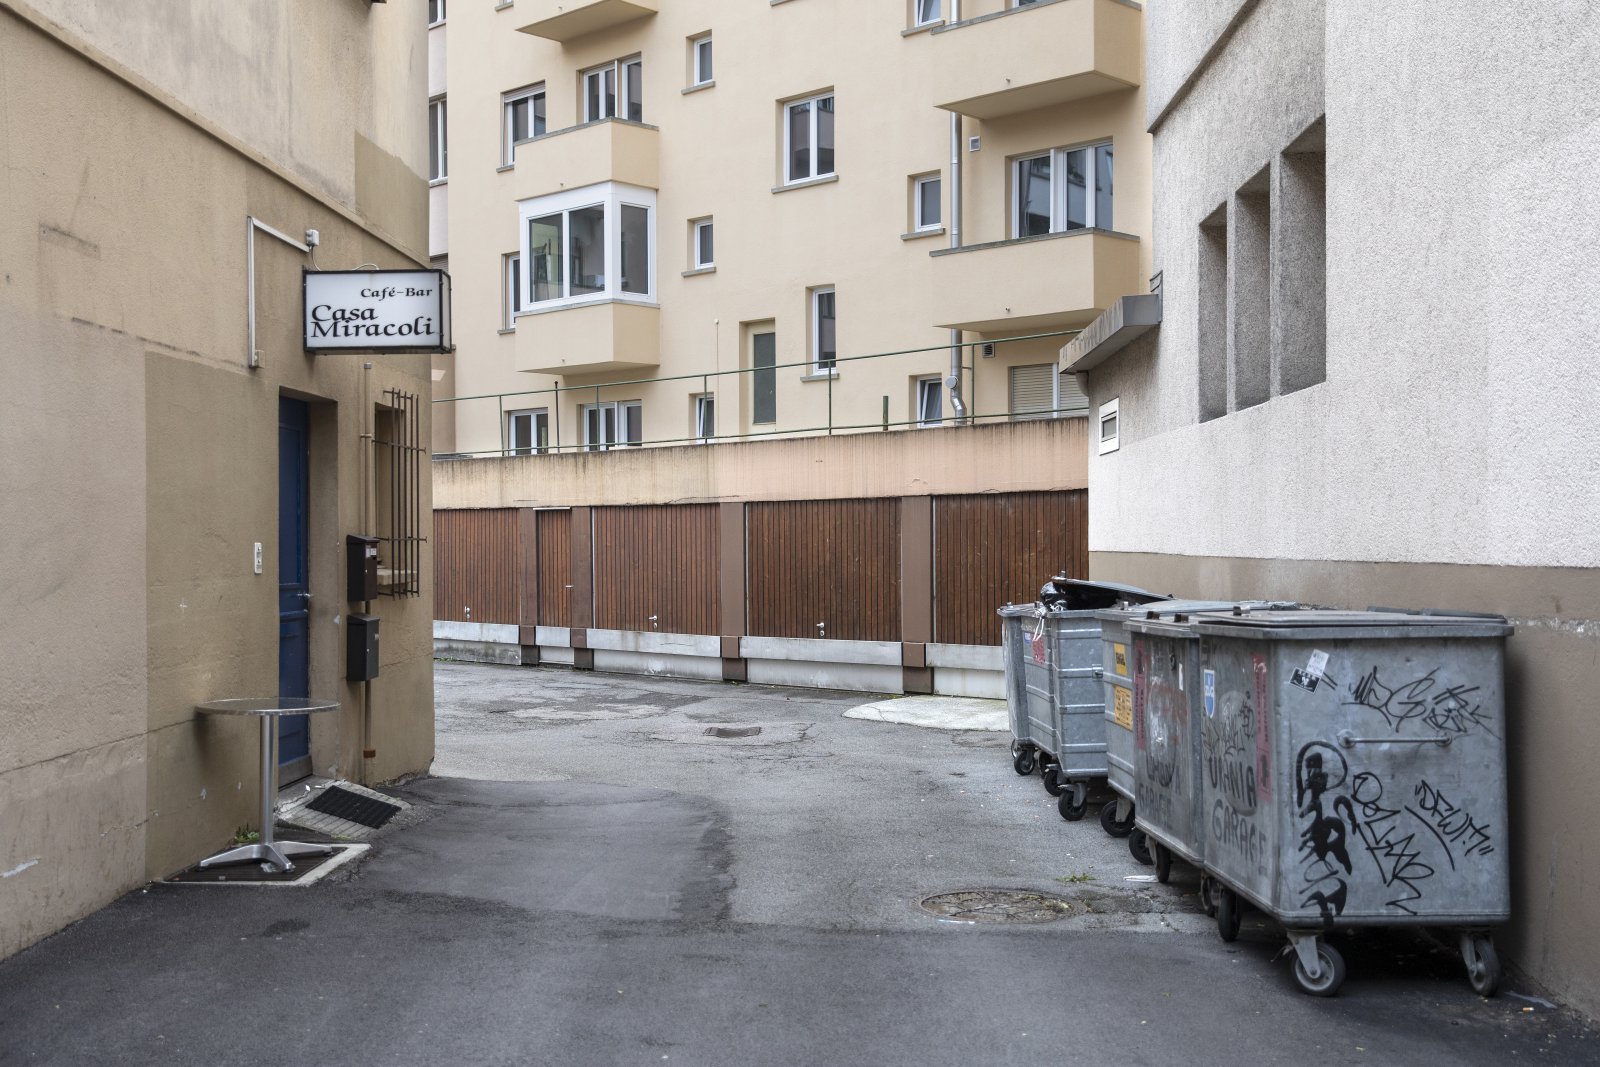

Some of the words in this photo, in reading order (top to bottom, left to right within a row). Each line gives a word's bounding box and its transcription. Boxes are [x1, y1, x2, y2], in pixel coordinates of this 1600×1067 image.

[360, 286, 433, 301] Café-Bar
[311, 304, 378, 322] Casa
[310, 316, 436, 338] Miracoli
